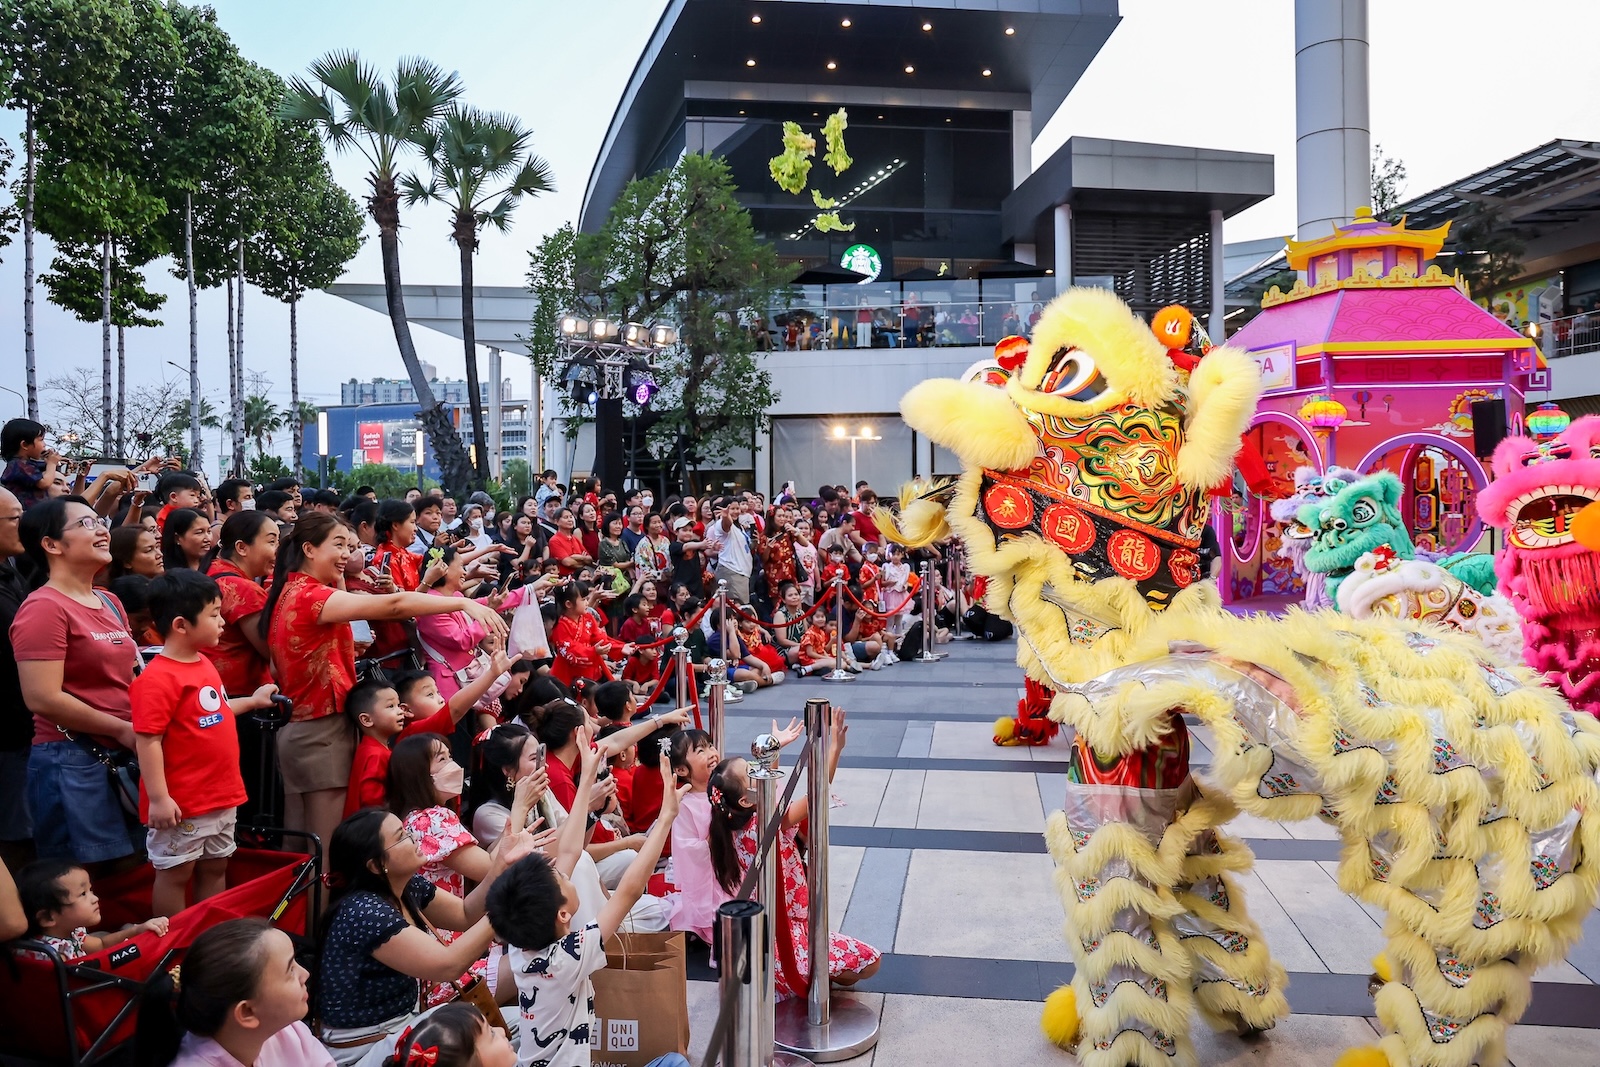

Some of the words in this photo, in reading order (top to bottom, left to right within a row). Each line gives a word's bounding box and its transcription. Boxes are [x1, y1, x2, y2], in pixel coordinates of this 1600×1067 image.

[1055, 515, 1080, 543] 國
[1118, 538, 1149, 571] 龍
[199, 714, 220, 728] SEE
[112, 945, 137, 962] MAC
[611, 1024, 633, 1035] UNI
[611, 1037, 635, 1049] QLO
